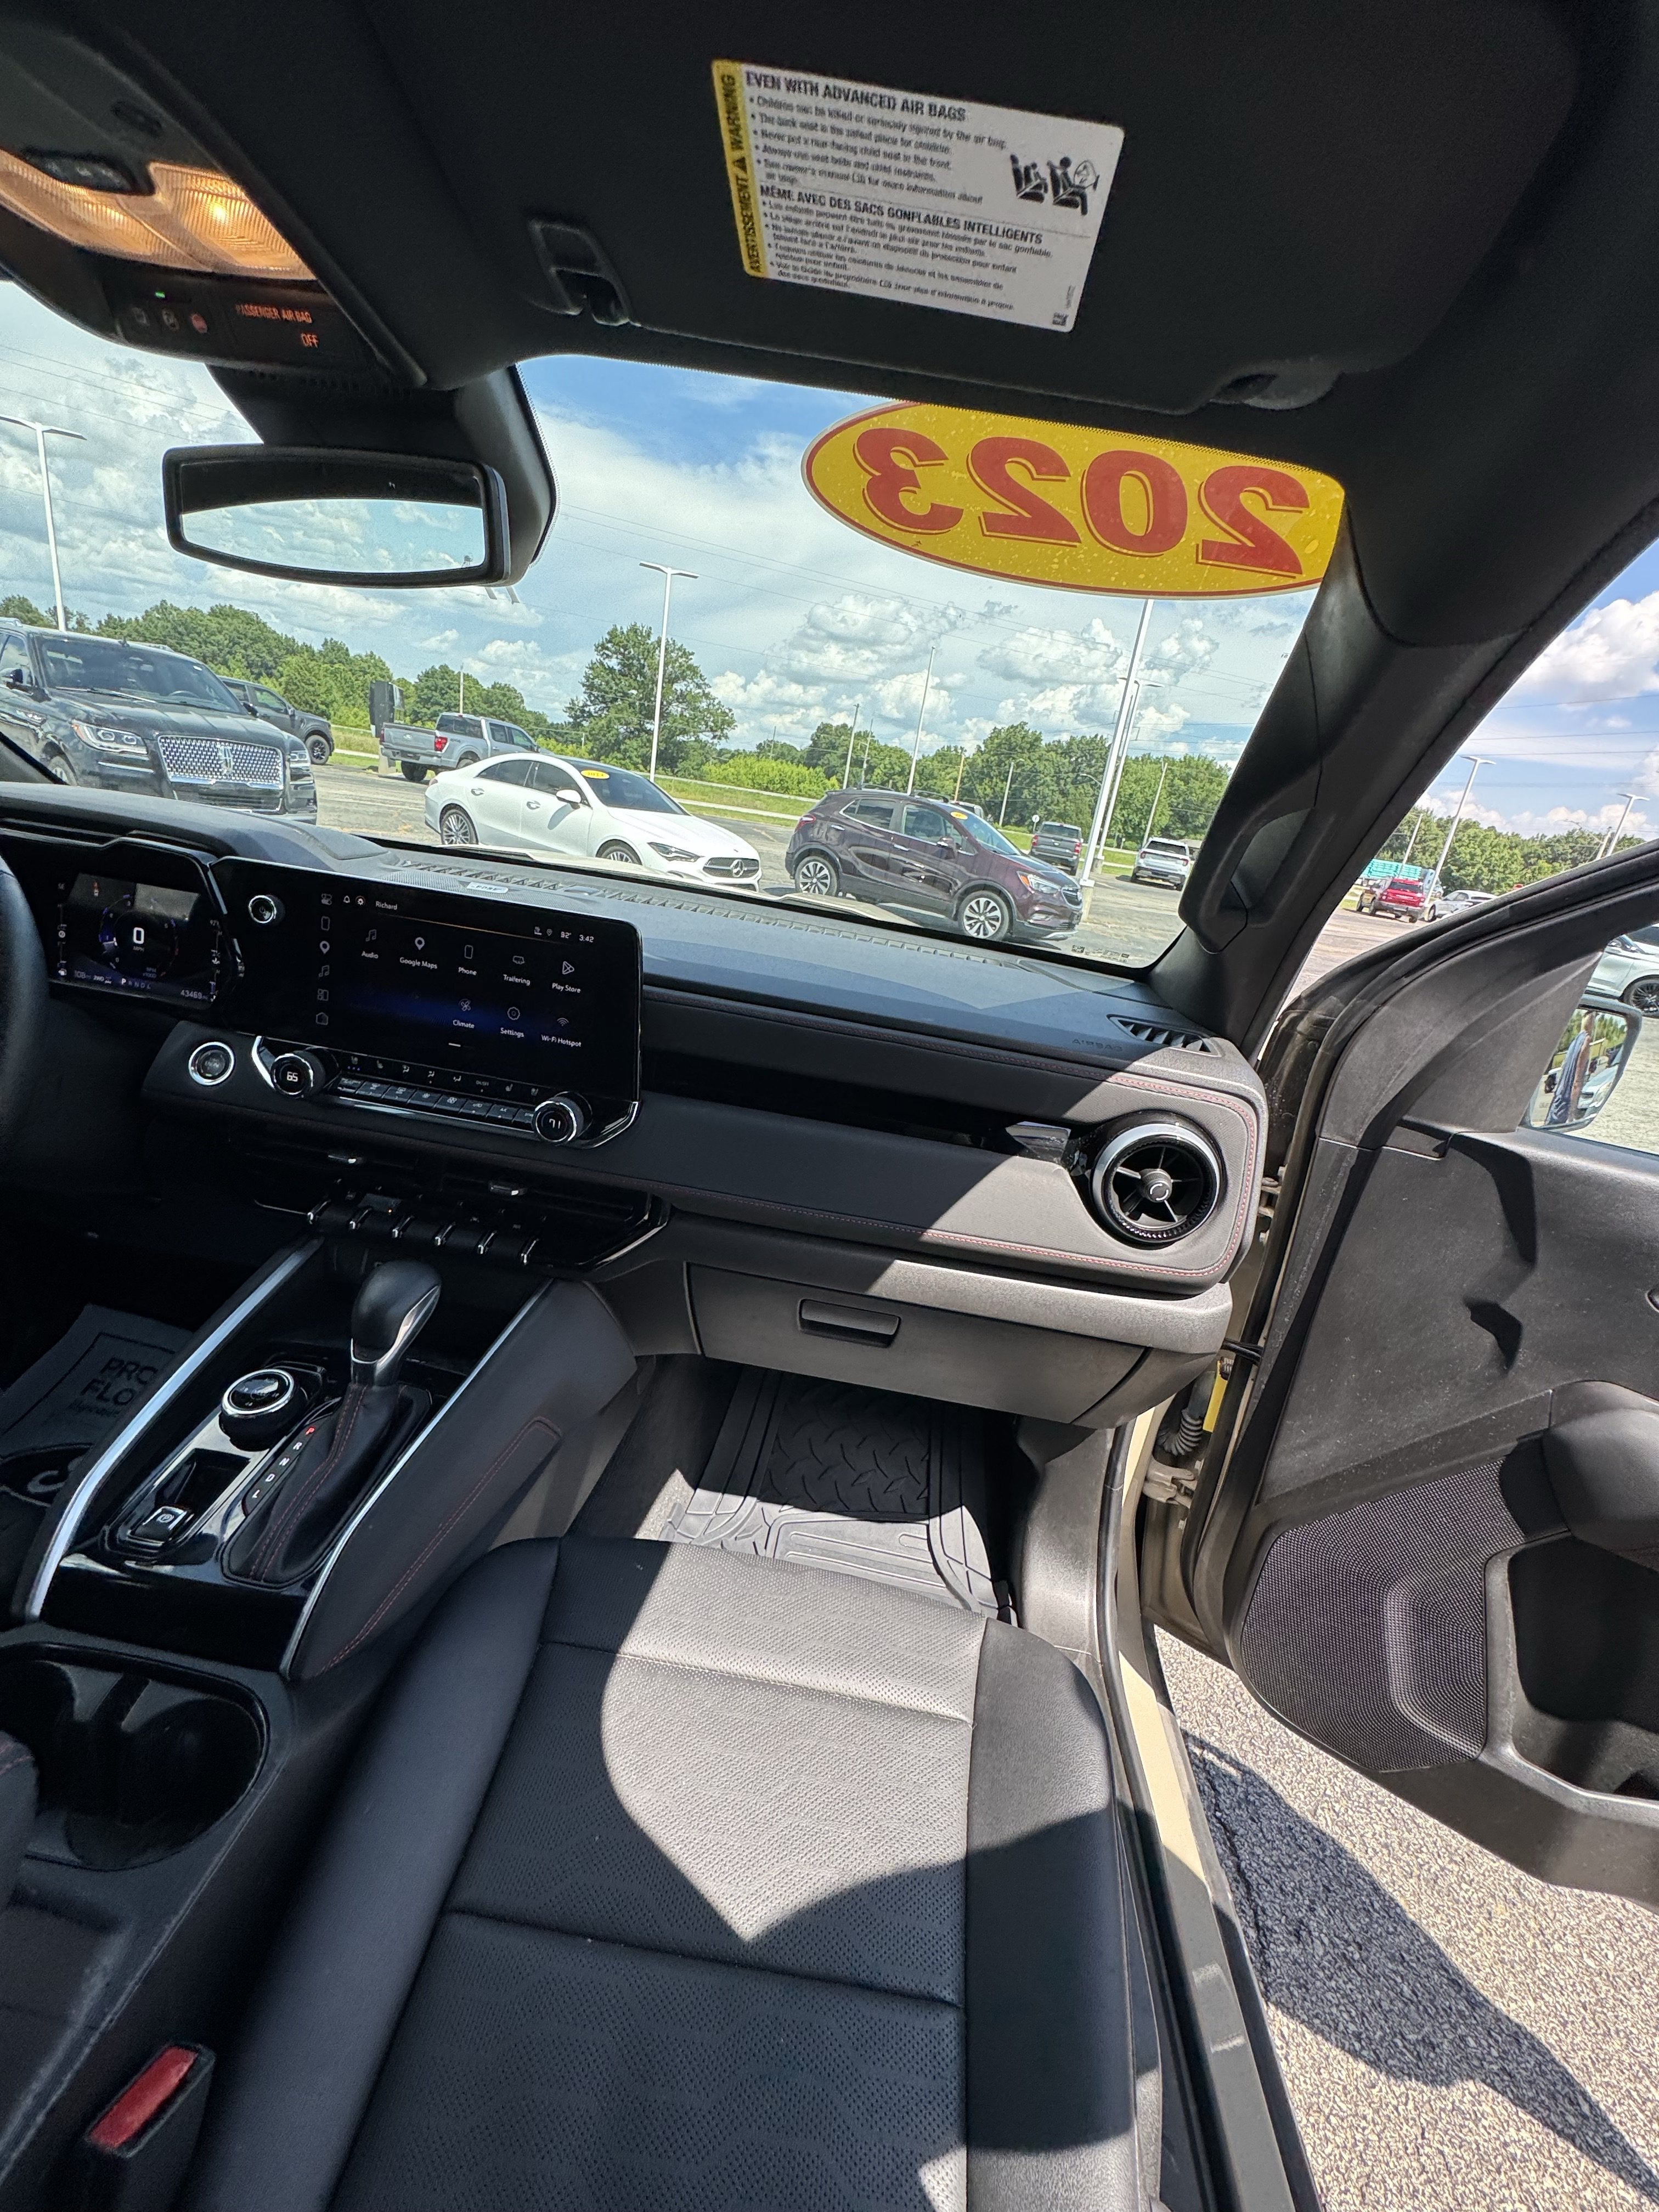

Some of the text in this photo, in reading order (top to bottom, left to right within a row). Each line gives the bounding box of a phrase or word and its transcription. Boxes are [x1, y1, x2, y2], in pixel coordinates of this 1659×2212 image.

[744, 70, 967, 122] EVEN WITH ADVANCED AIR BAGS
[721, 74, 744, 151] WARNING
[797, 190, 826, 206] AVEC
[855, 201, 883, 216] SACS
[963, 220, 1043, 244] INTELLIGENTS
[235, 303, 313, 324] PASSENGER AIR BAG
[301, 332, 319, 348] OFF
[375, 900, 398, 911] Richard
[133, 927, 145, 945] 0
[579, 934, 594, 943] 3:42
[362, 951, 379, 959] Audio
[399, 957, 438, 969] Google Maps
[458, 967, 477, 975] Phone
[503, 974, 531, 986] Trailering
[180, 989, 202, 999] 43469
[552, 983, 581, 994] Play Store
[453, 1019, 475, 1029] Climate
[500, 1027, 524, 1038] Settings
[541, 1034, 582, 1047] Wi-Fi Hotspot
[286, 1071, 298, 1082] 65
[549, 1118, 561, 1130] 71
[305, 1427, 315, 1436] P
[292, 1442, 303, 1450] R
[279, 1457, 290, 1466] N
[265, 1473, 275, 1482] D
[252, 1489, 261, 1498] L
